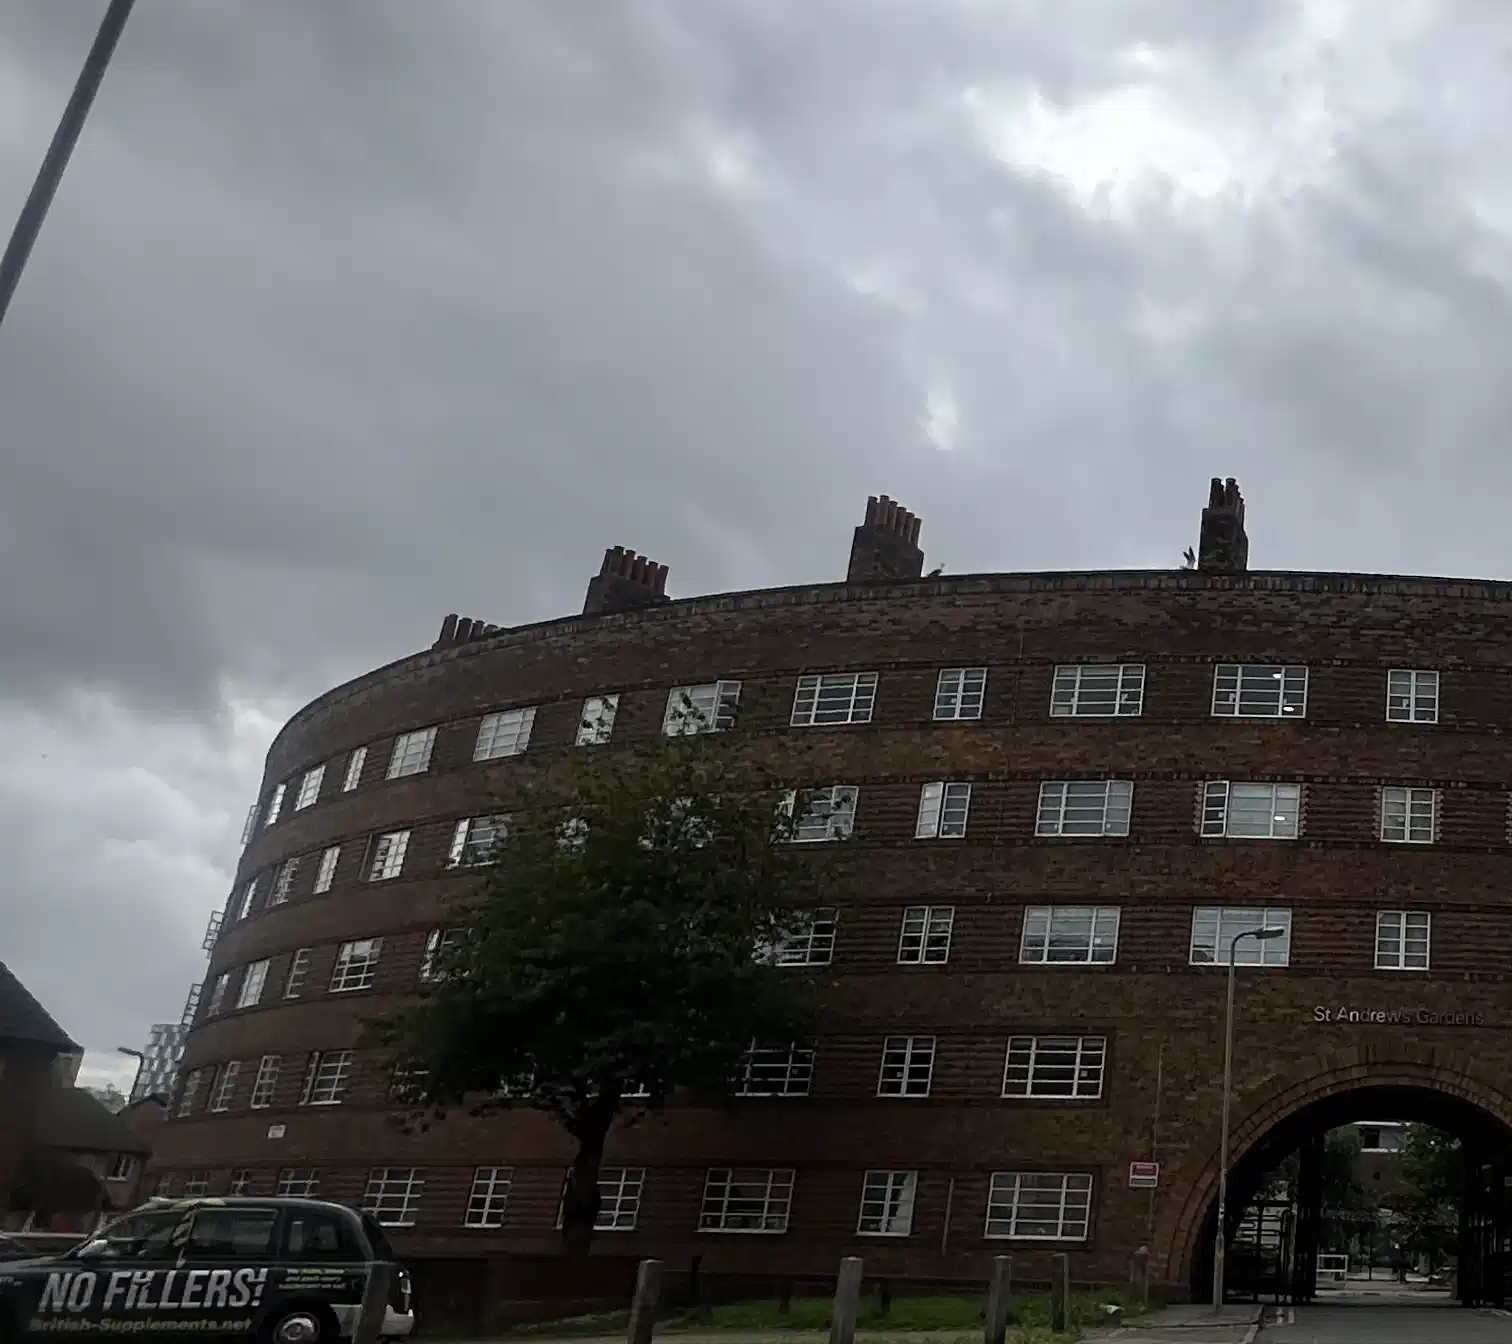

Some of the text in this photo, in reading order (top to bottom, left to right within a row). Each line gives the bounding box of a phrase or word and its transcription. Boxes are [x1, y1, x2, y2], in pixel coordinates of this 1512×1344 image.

[1313, 1005, 1485, 1025] St Andrews Gardens
[38, 1272, 97, 1313] NO
[29, 1316, 252, 1334] British-Supplements.net
